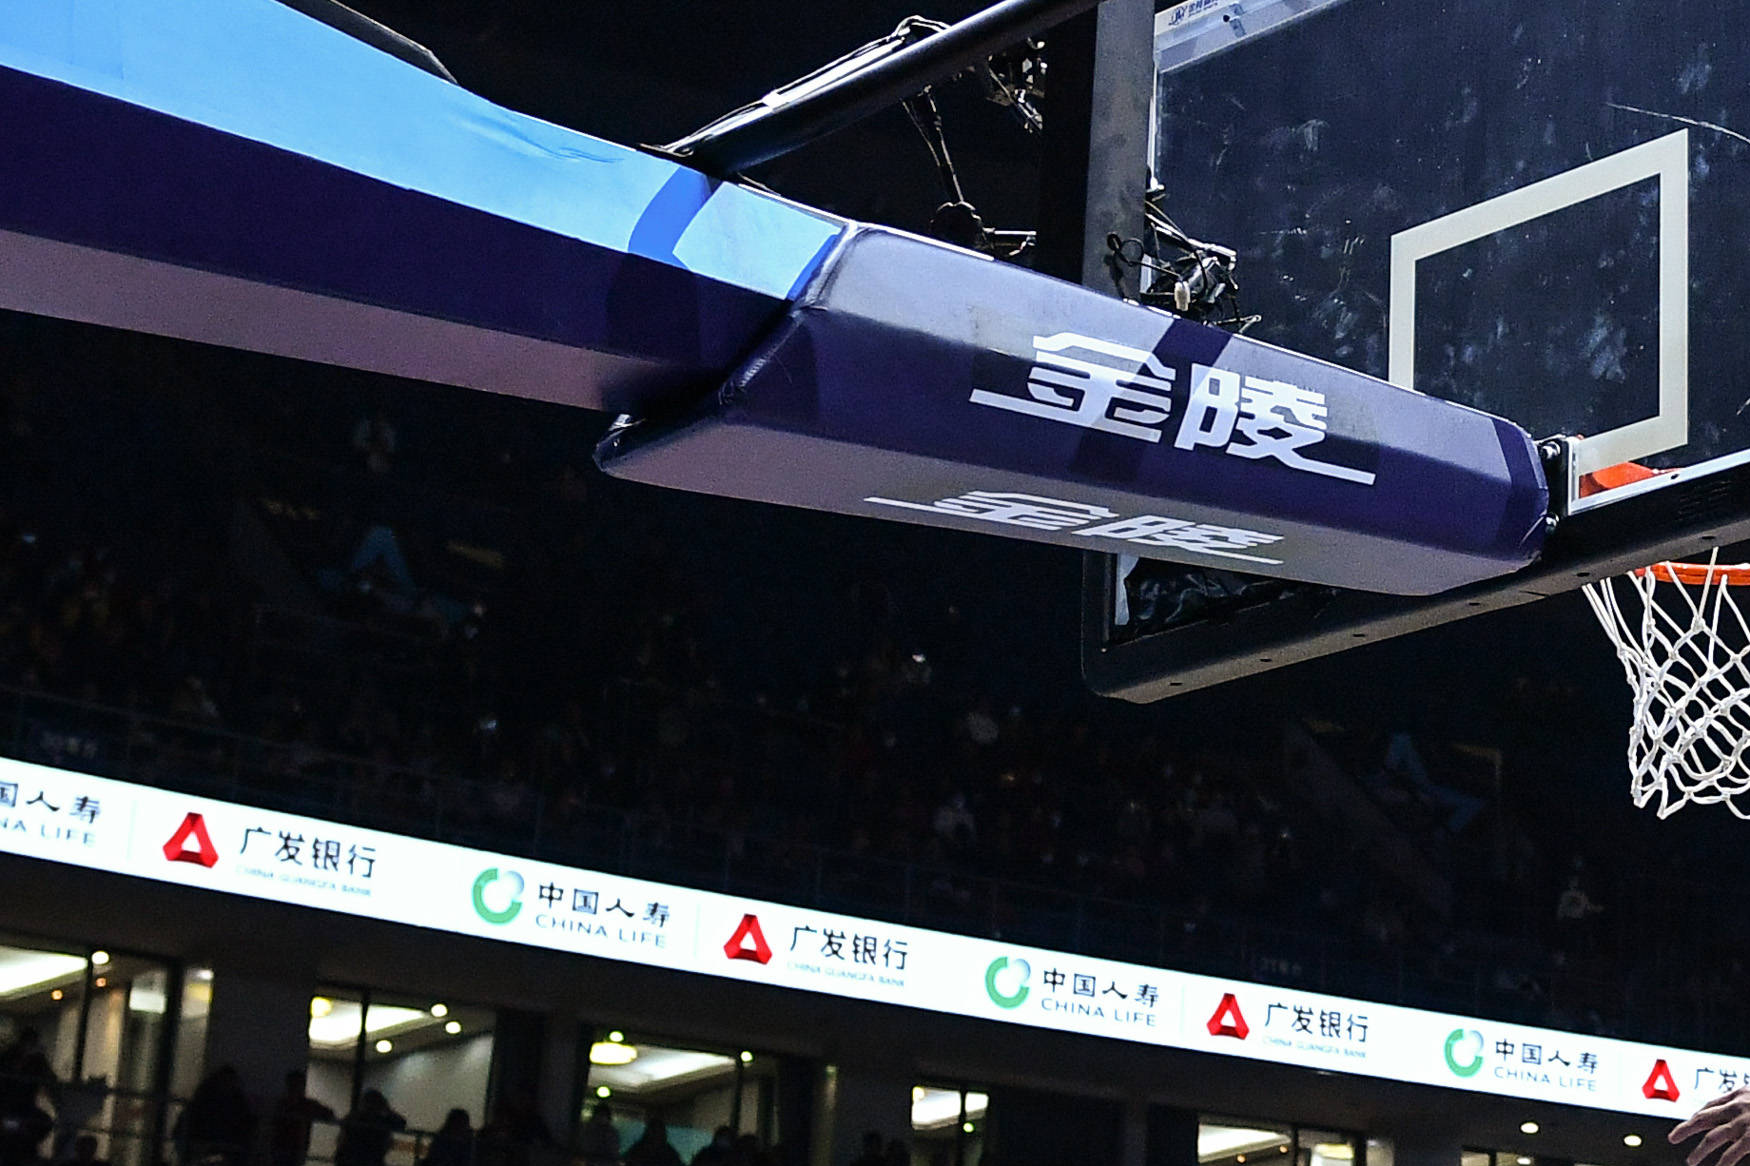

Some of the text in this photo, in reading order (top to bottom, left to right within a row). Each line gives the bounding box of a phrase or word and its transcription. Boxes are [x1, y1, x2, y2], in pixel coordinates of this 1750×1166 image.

[969, 331, 1376, 486] 金陵
[864, 490, 1284, 566] 金陵
[41, 825, 96, 847] LIFE
[240, 827, 376, 878] 广发银行
[538, 881, 671, 928] 中国人寿
[535, 913, 667, 949] CHINA LIFE
[790, 925, 909, 970] 广发银行
[1043, 967, 1160, 1008] 中国人寿
[1041, 998, 1157, 1028] CHINA LIFE
[1264, 1002, 1369, 1043] 广发银行
[1495, 1038, 1598, 1075] 中国人寿
[1494, 1066, 1598, 1093] CHINA LIFE
